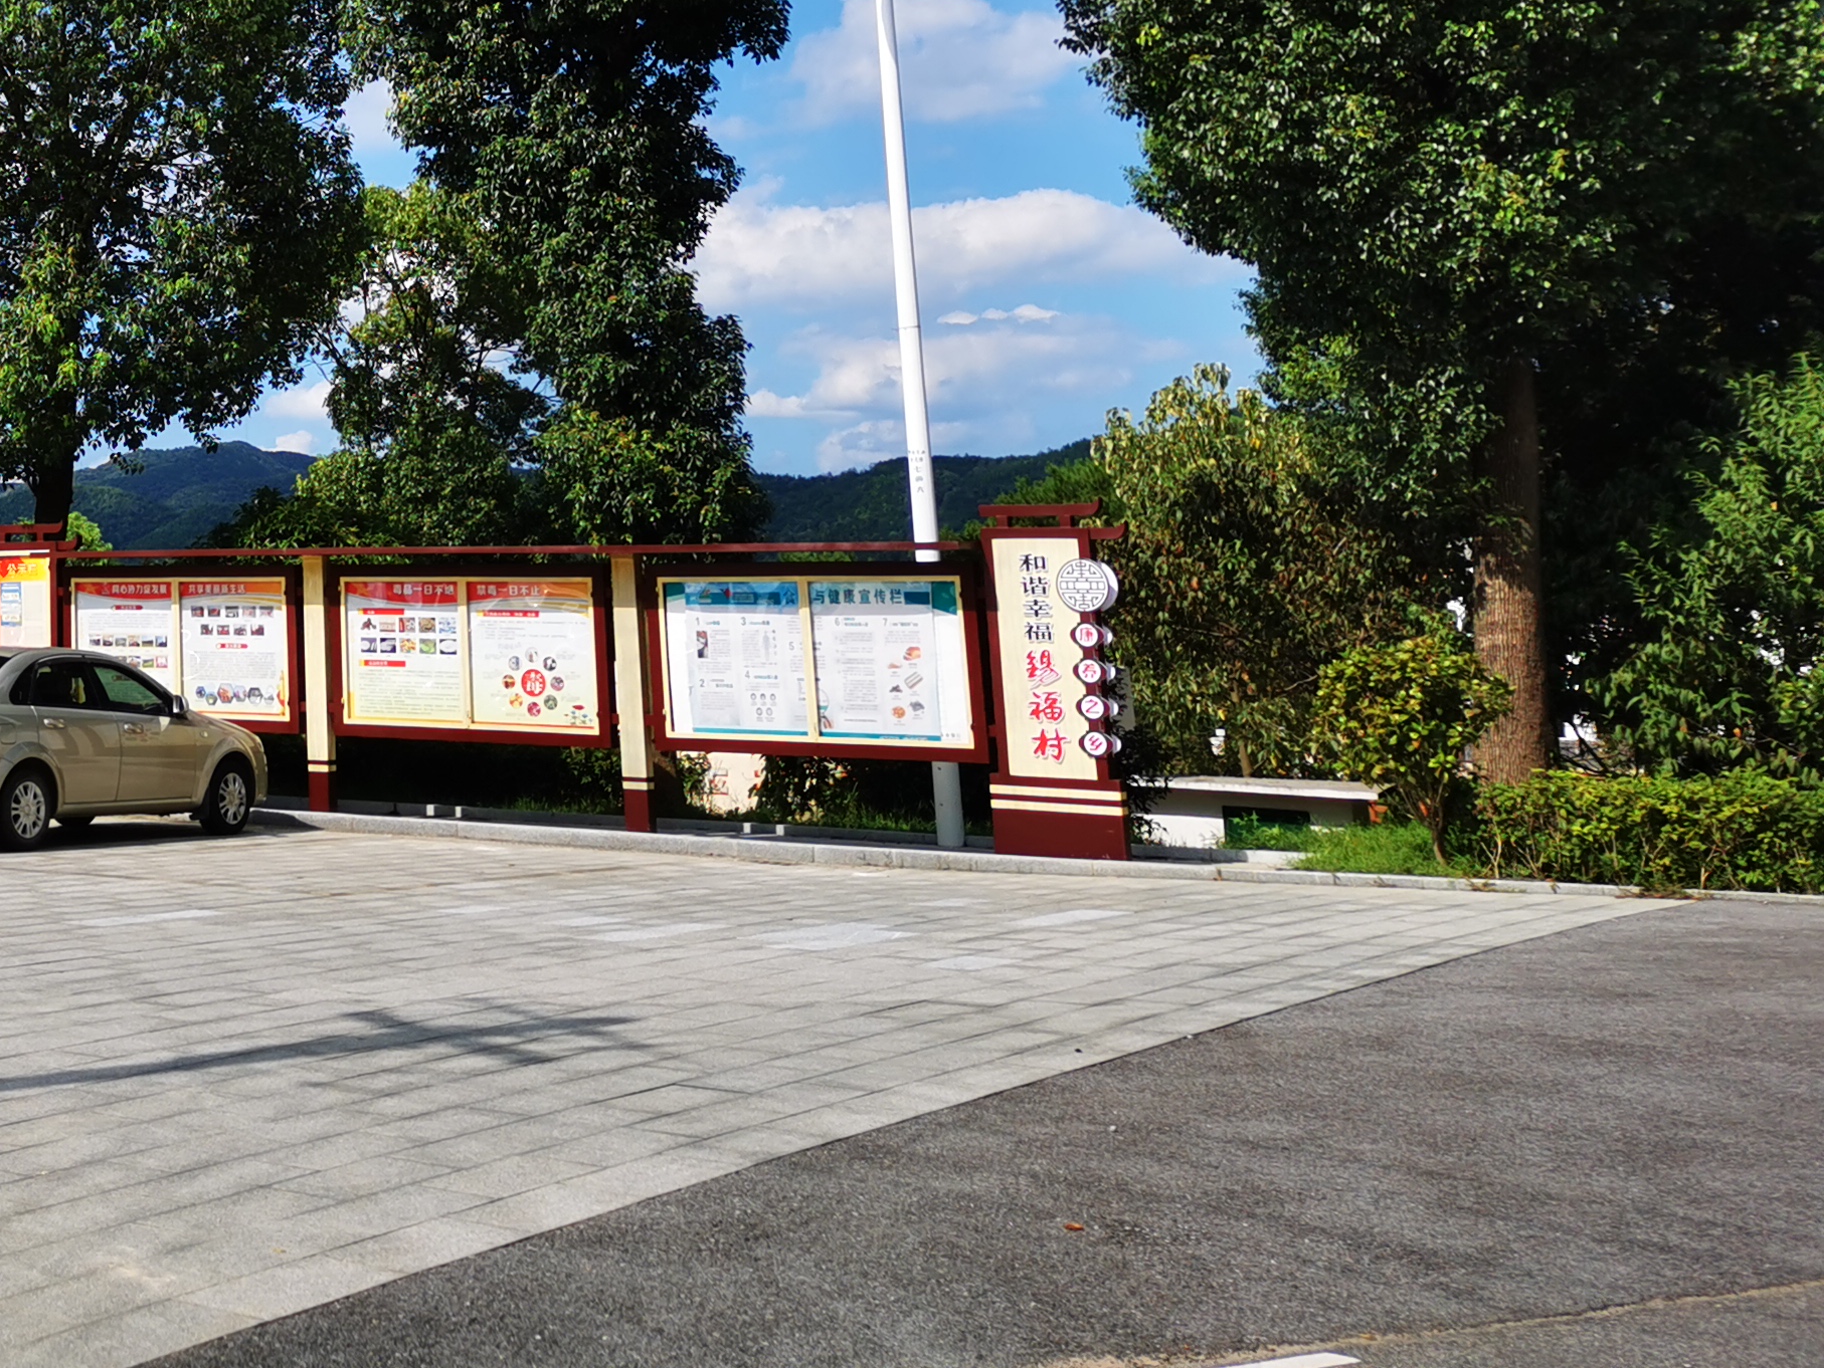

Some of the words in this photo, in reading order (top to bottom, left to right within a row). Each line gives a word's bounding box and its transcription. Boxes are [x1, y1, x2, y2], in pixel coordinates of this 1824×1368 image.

[476, 584, 540, 596] 禁毒一日不止
[1019, 553, 1052, 641] 和谐幸福
[1079, 627, 1103, 751] 康养之乡
